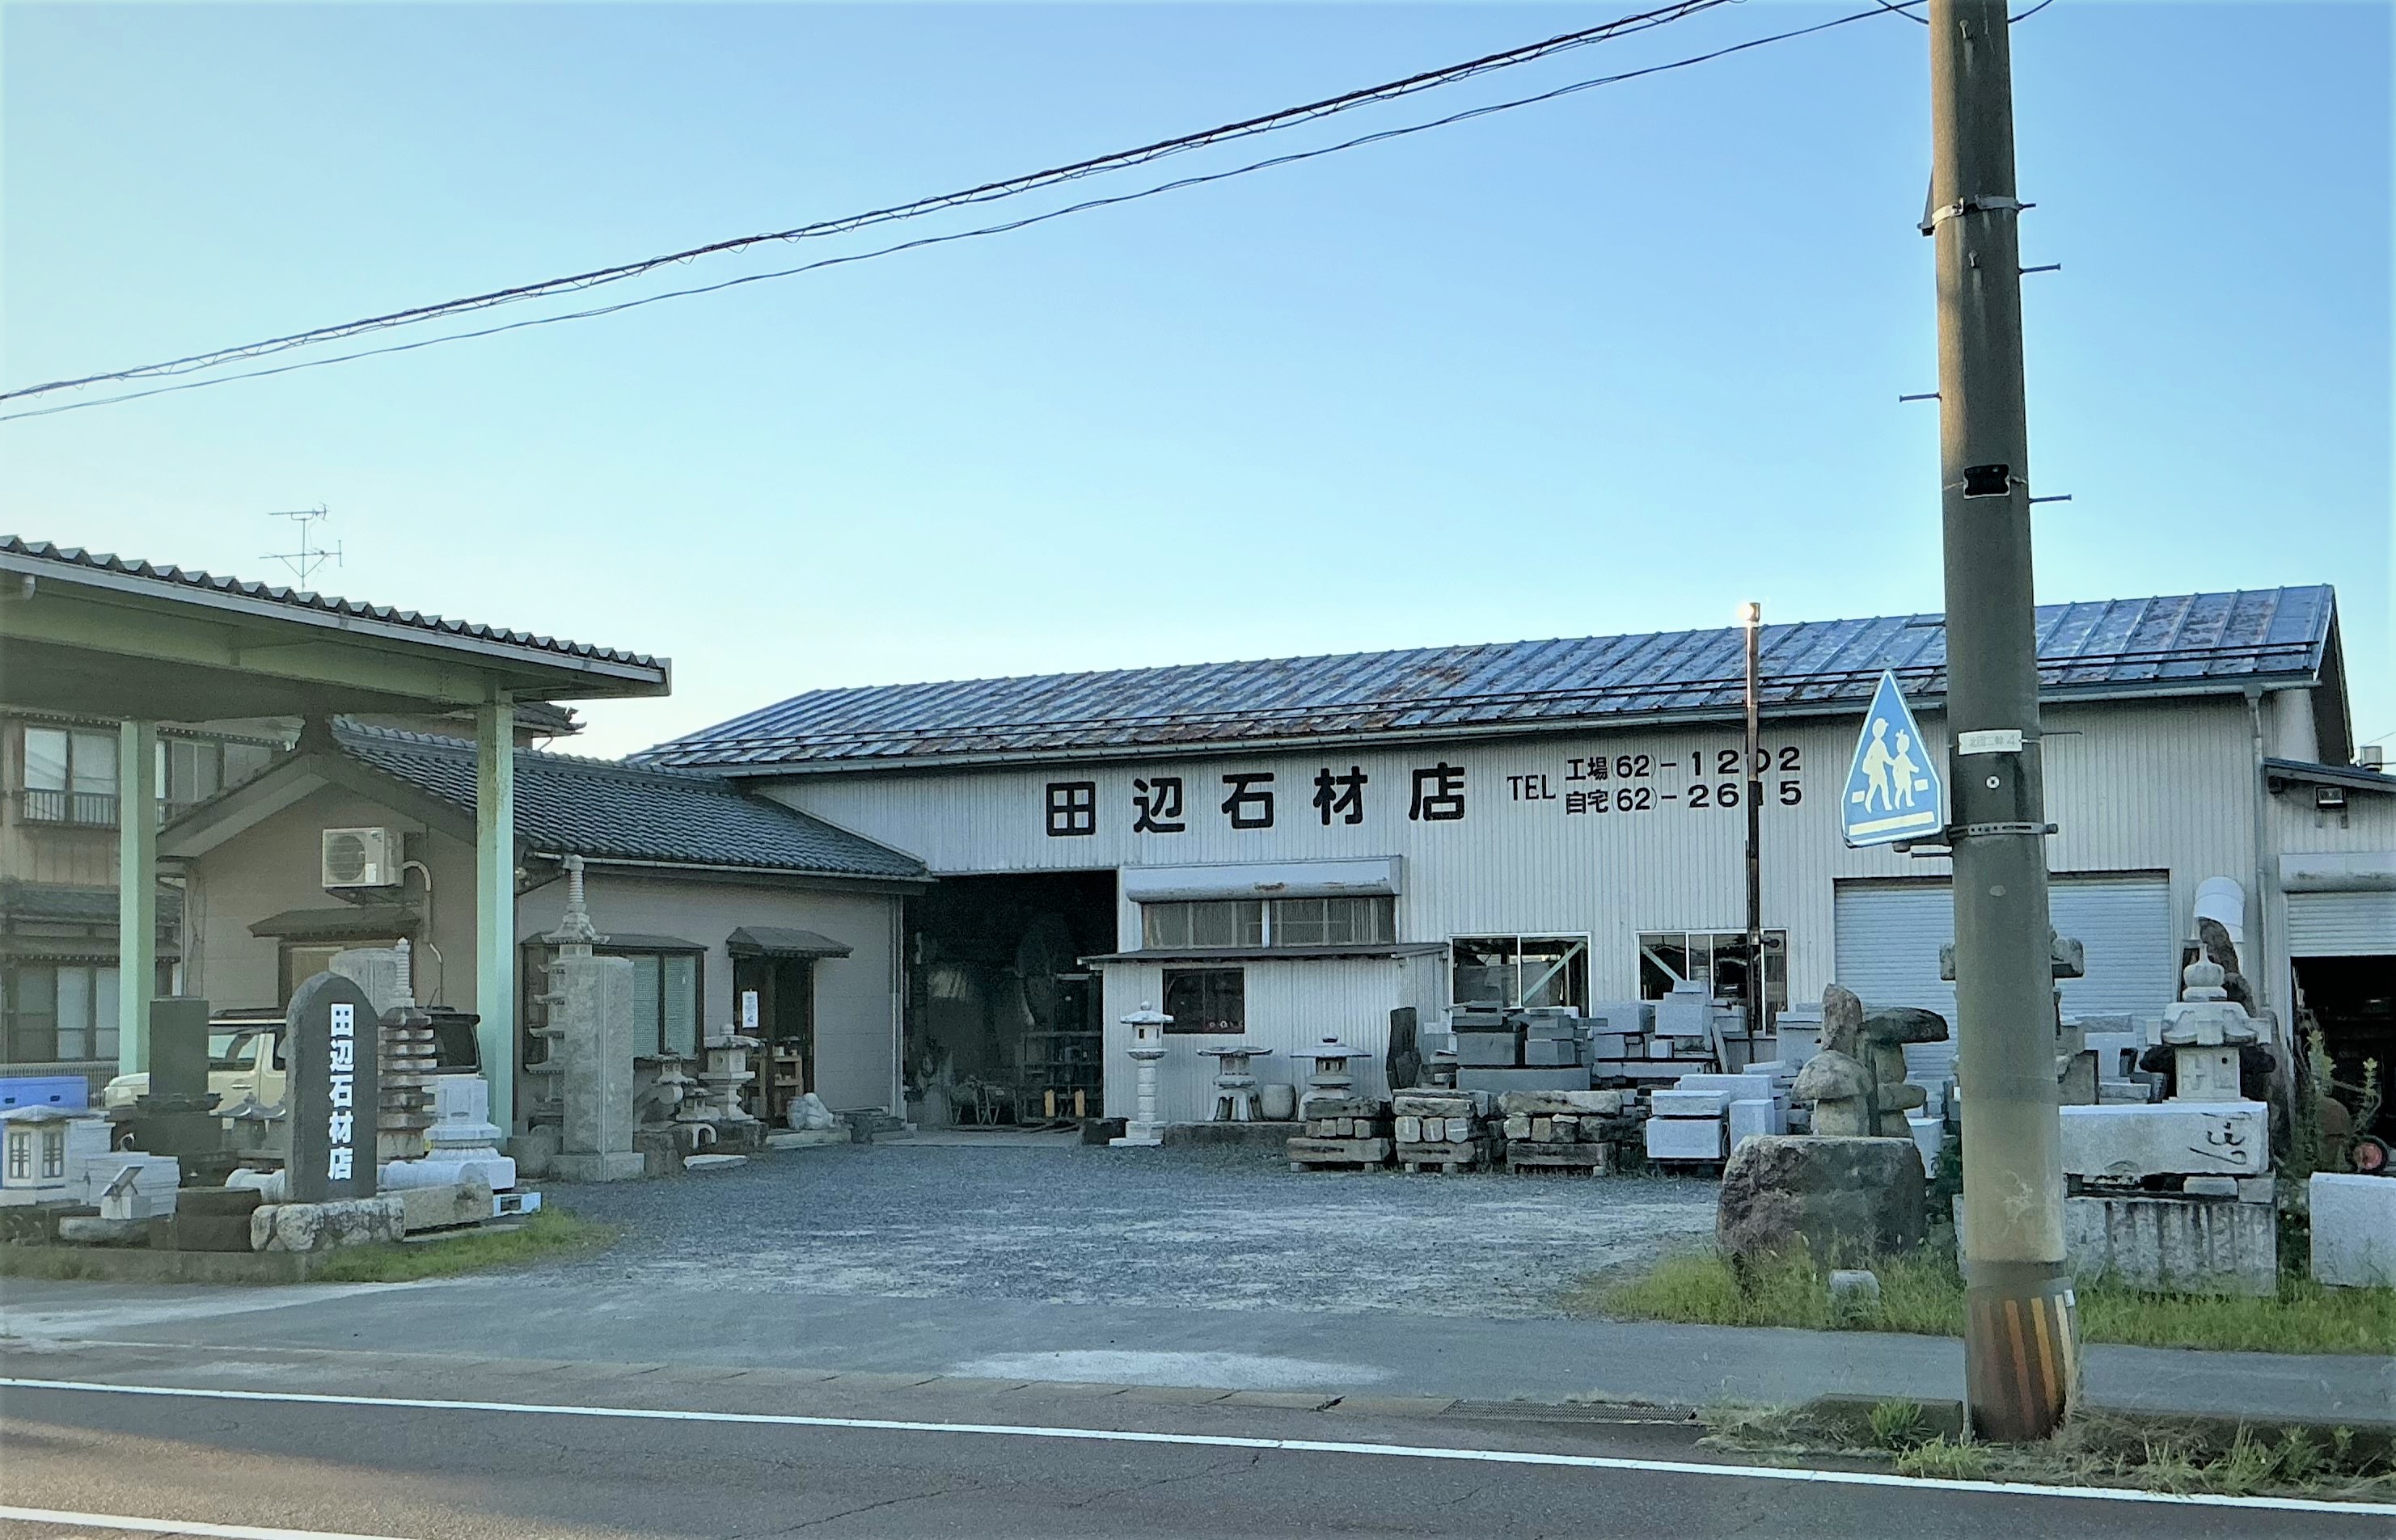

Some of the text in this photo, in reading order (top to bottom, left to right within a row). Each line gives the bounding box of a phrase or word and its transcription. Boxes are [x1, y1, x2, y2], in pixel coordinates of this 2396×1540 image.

[1046, 762, 1466, 837] 田辺石材店
[1506, 774, 1557, 801] TEL
[327, 1003, 355, 1180] 田辺石材店
